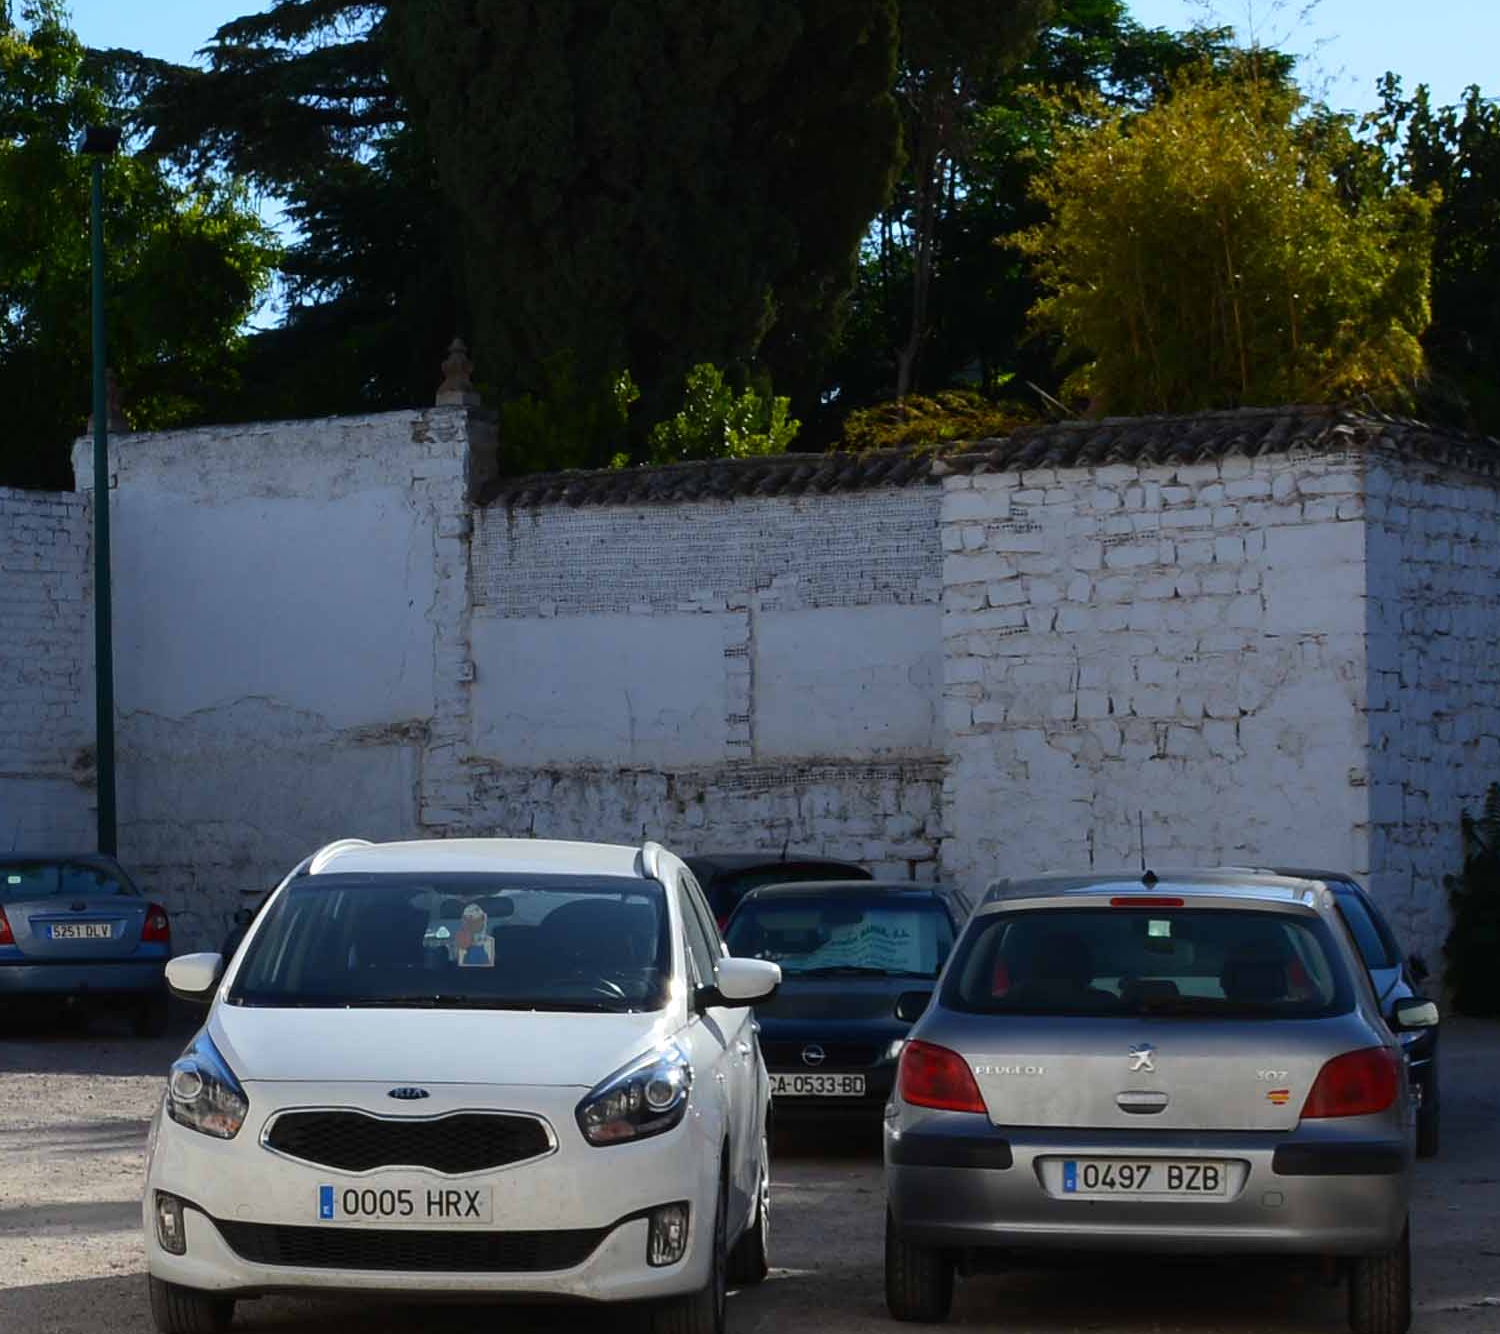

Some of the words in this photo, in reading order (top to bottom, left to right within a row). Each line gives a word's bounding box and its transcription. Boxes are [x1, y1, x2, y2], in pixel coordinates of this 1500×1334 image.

[53, 925, 81, 938] 5251
[1084, 1164, 1152, 1189] 0497
[1168, 1165, 1218, 1190] BZB
[343, 1189, 413, 1215] 0005
[427, 1190, 480, 1216] HRX
